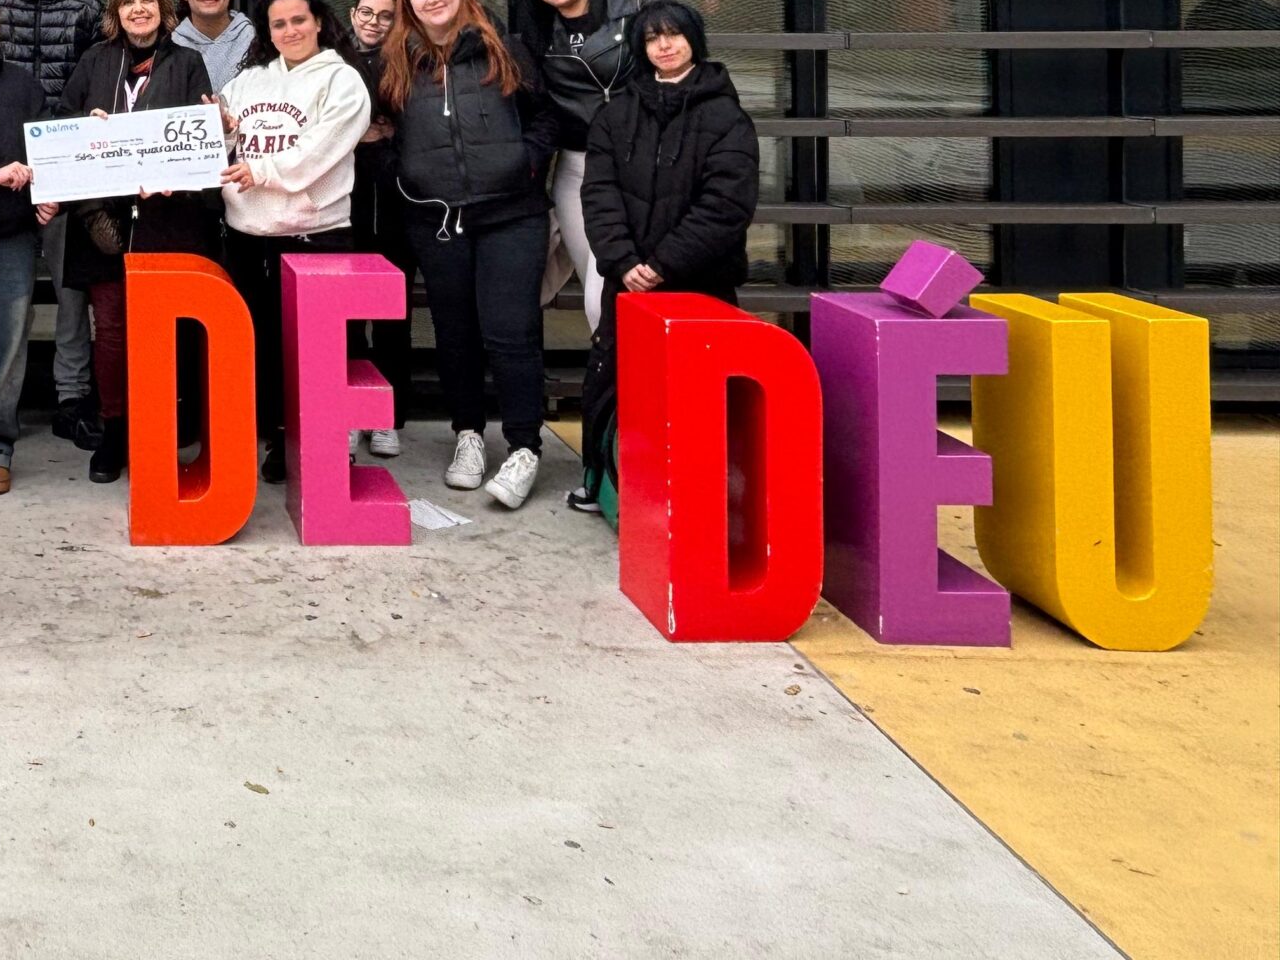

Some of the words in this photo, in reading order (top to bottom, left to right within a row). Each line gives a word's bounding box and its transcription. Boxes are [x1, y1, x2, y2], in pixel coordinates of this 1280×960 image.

[45, 123, 80, 134] balmes
[163, 119, 208, 143] 643
[237, 132, 301, 154] PARIS
[125, 252, 412, 547] DE
[616, 240, 1214, 652] DÉU
